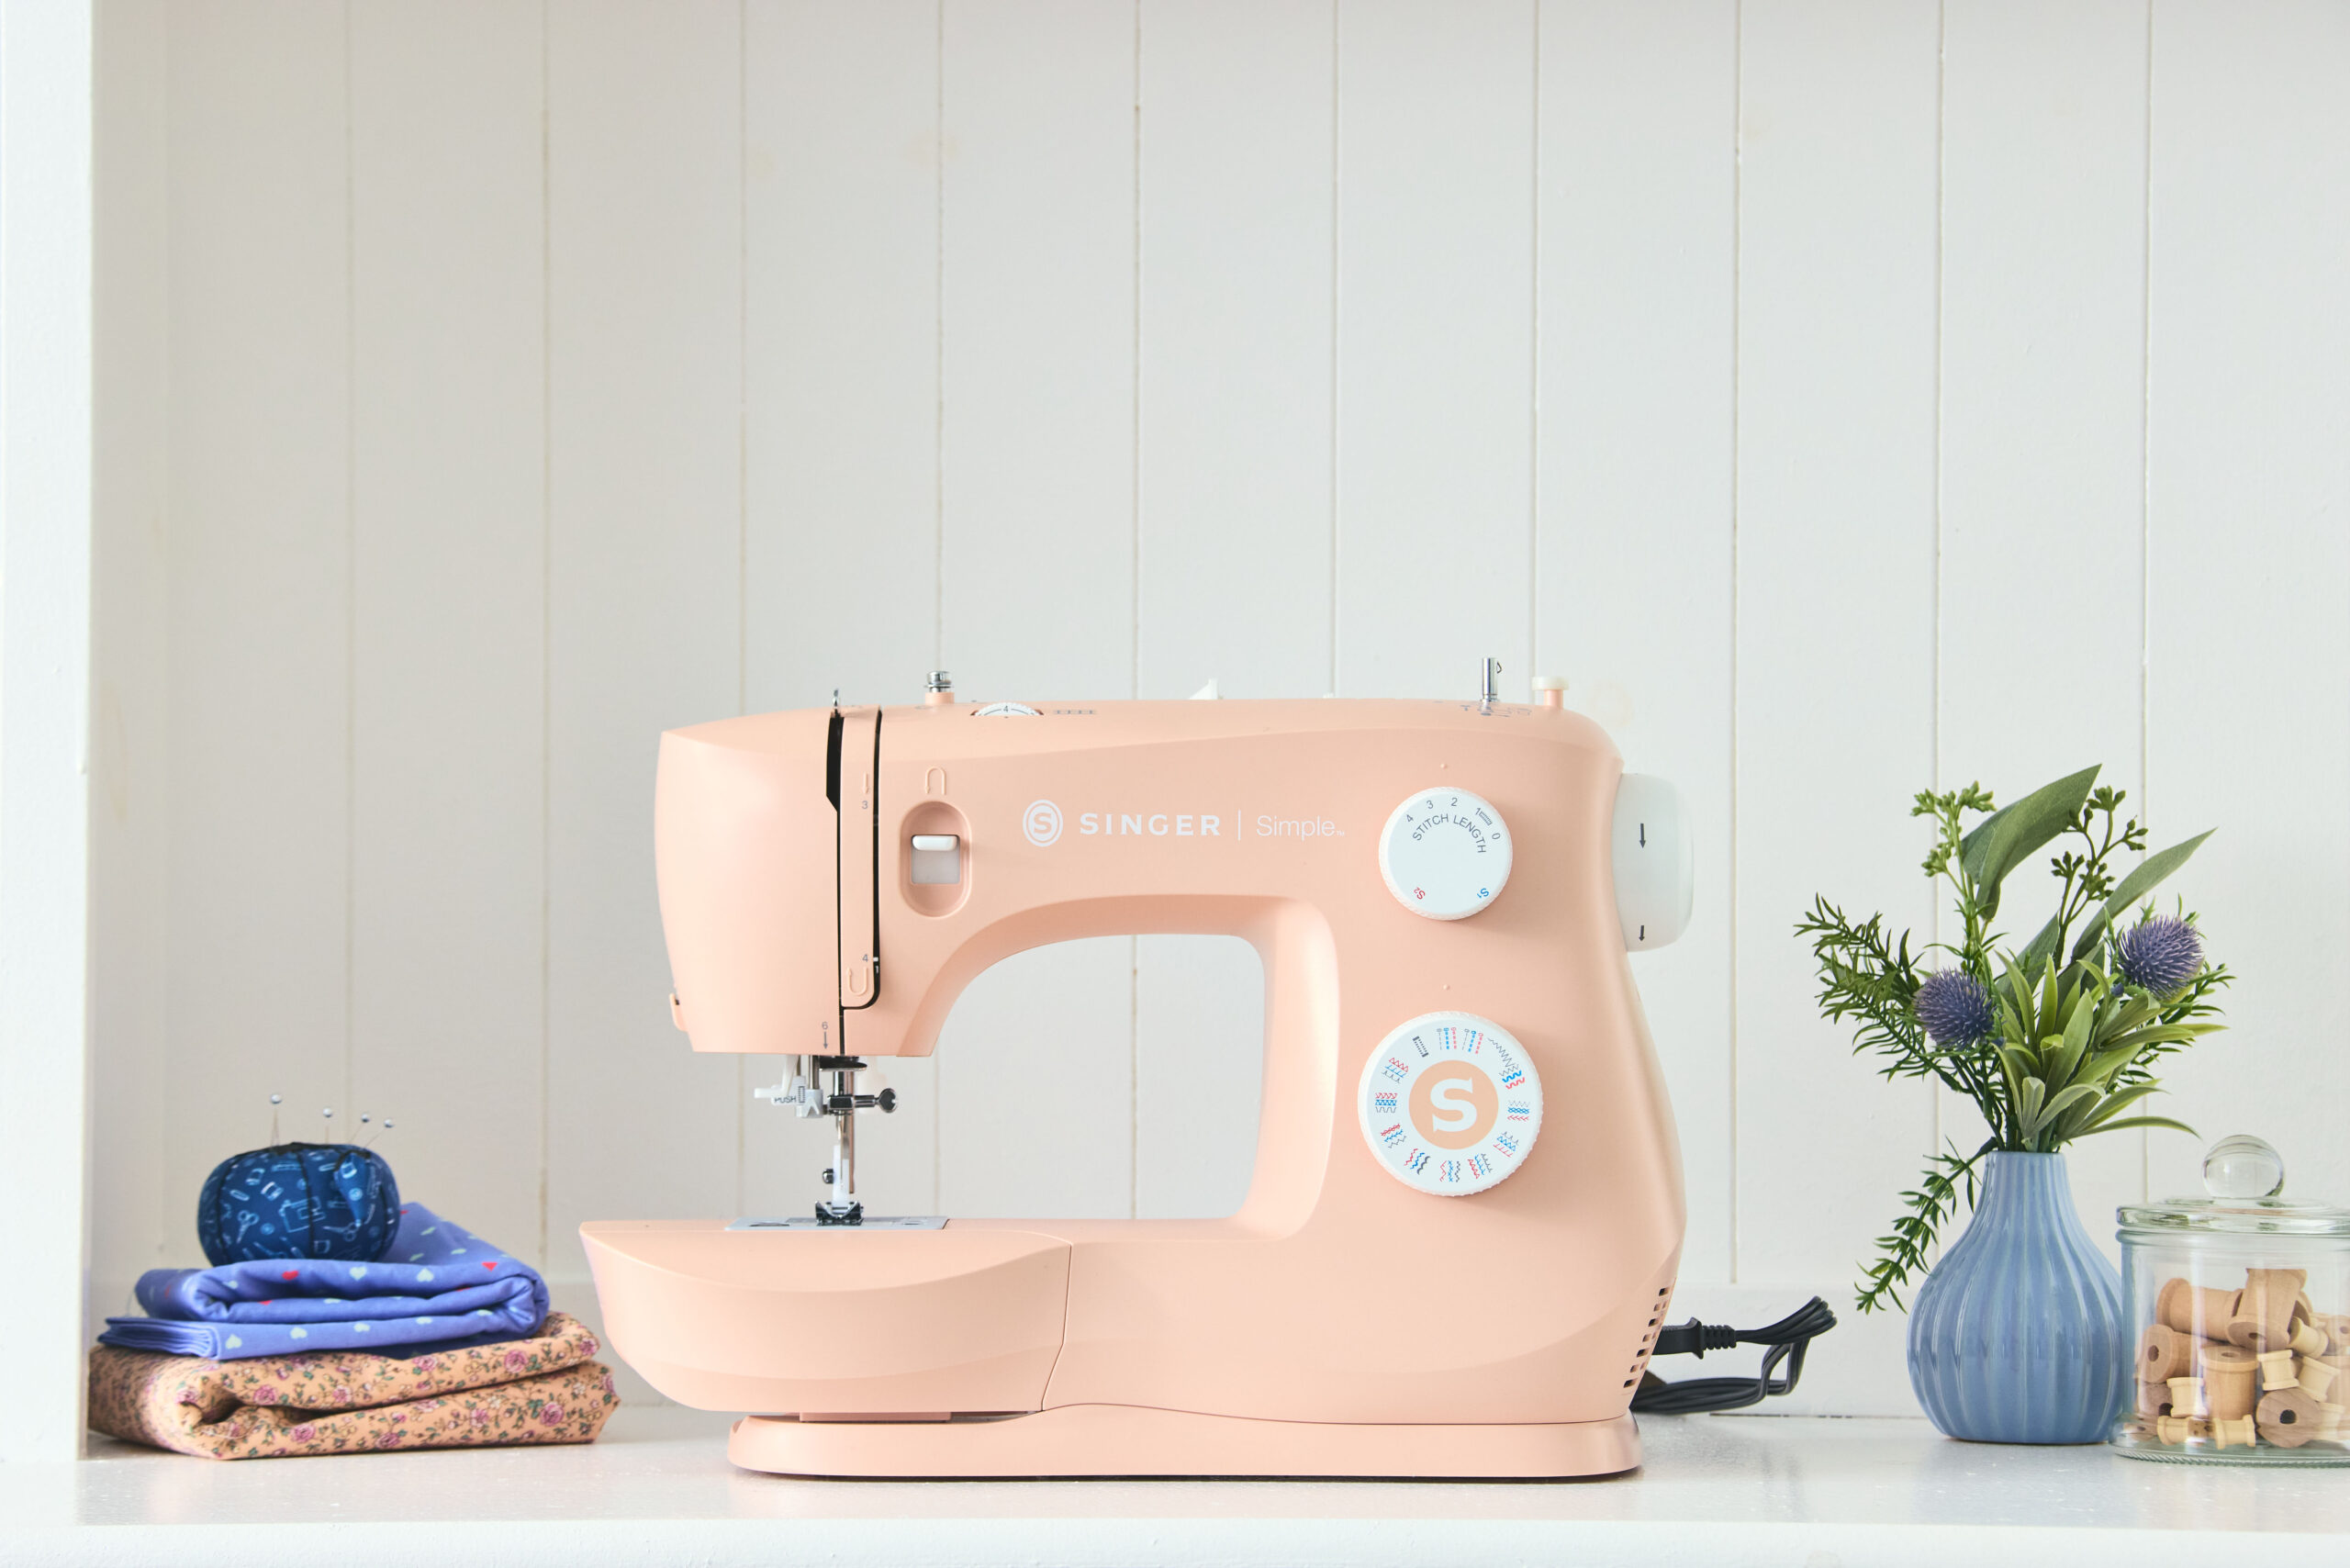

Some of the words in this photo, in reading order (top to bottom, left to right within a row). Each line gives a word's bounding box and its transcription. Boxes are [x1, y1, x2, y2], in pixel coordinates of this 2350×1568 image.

[861, 800, 868, 810] 3
[1080, 812, 1221, 835] SINGER
[1405, 813, 1415, 823] 4
[1426, 800, 1434, 809] 3
[1450, 797, 1458, 807] 2
[1491, 832, 1501, 840] 0
[1412, 813, 1449, 841] STITCH
[1452, 814, 1487, 854] LENGTH
[862, 954, 868, 963] 4
[822, 1021, 829, 1030] 6
[1429, 1077, 1478, 1133] S
